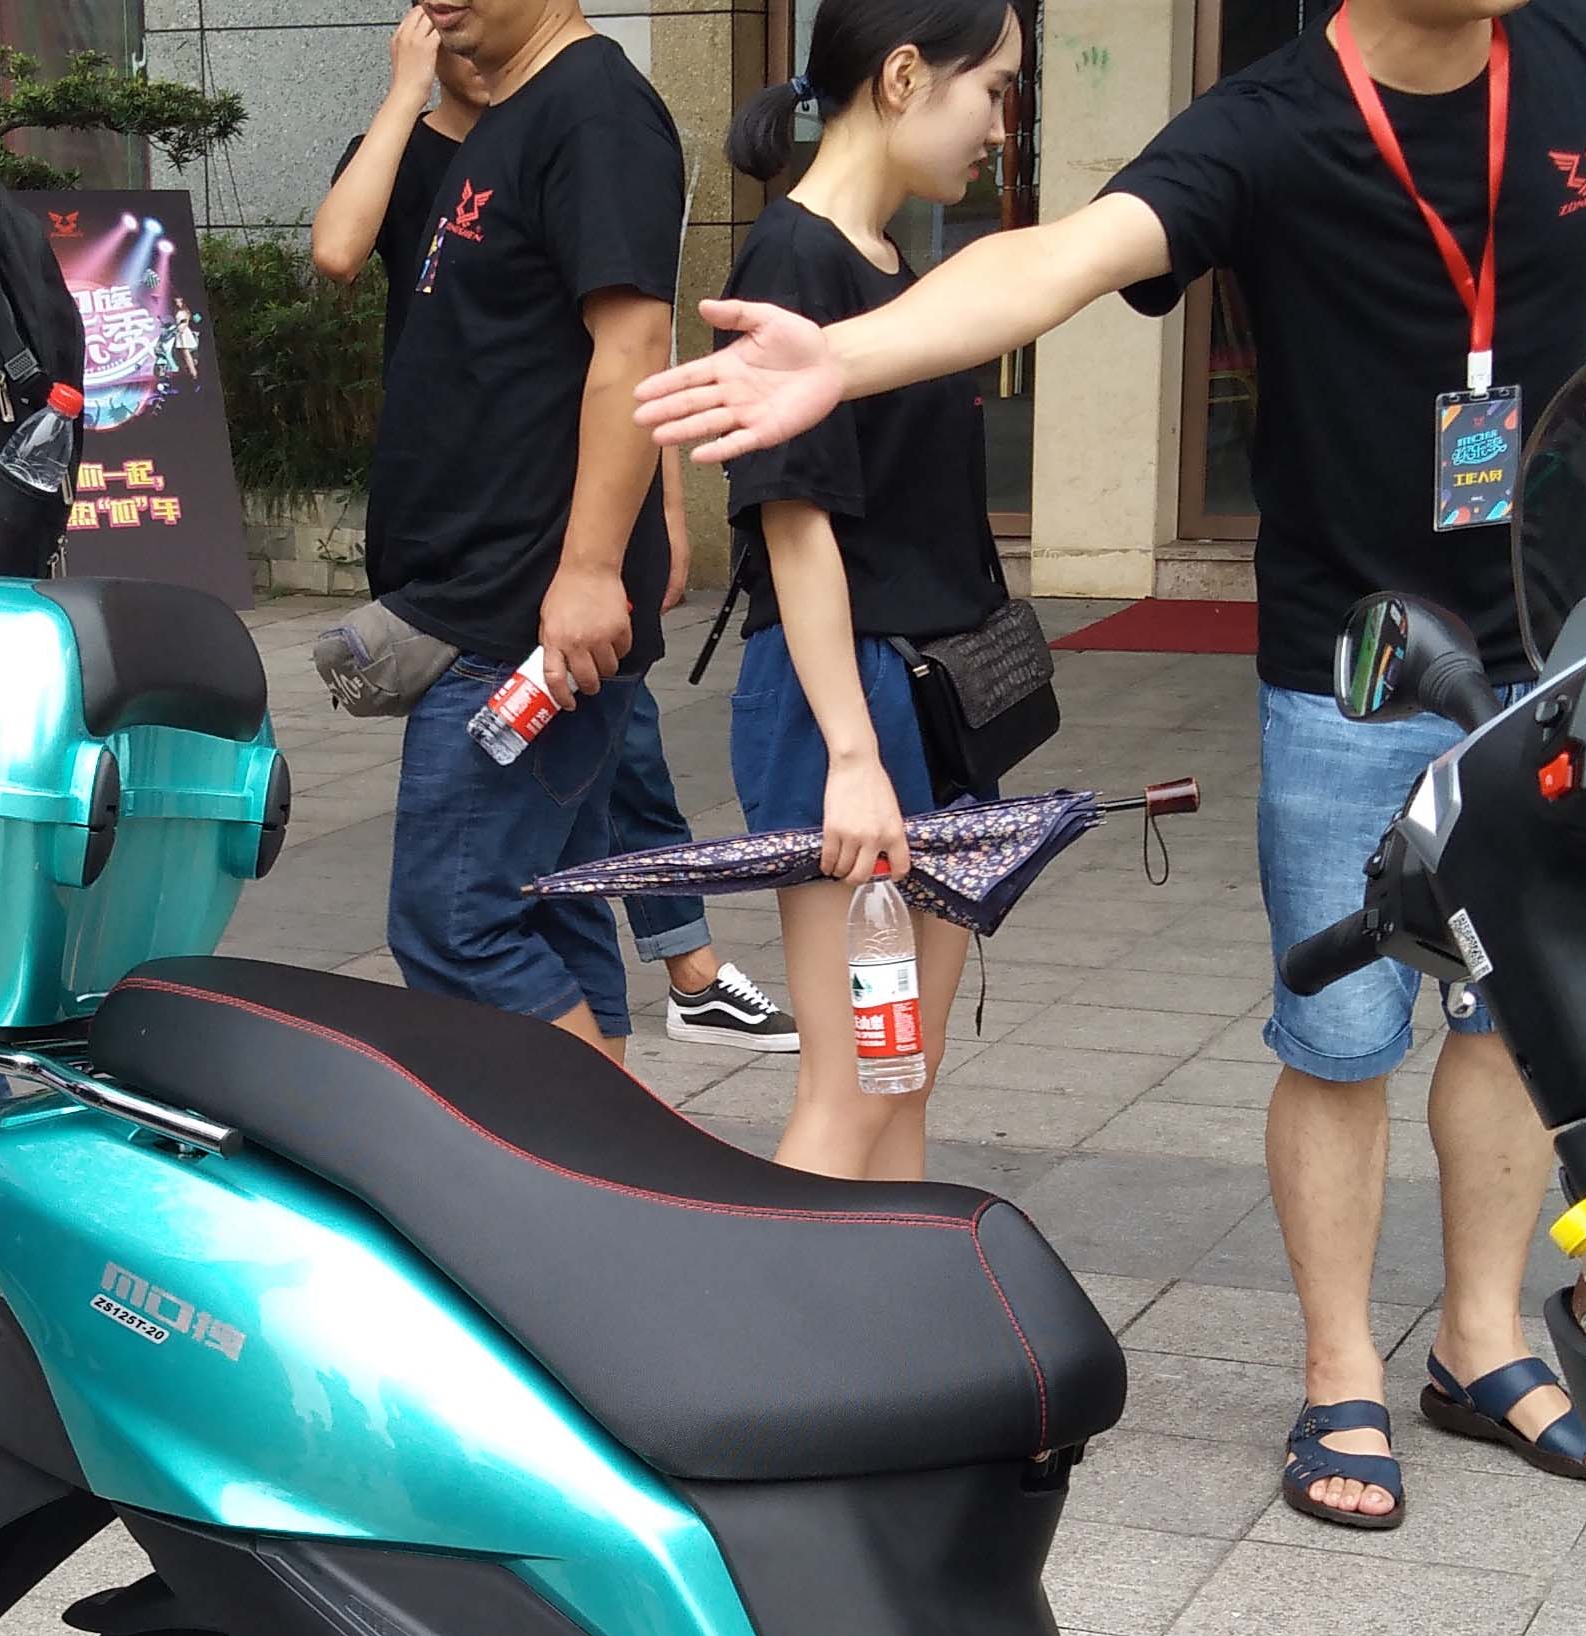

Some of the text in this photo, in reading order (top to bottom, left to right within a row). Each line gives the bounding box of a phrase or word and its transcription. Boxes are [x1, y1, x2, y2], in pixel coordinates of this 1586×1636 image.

[1453, 469, 1503, 487] 工作人员
[94, 1297, 165, 1341] ZS125T-20
